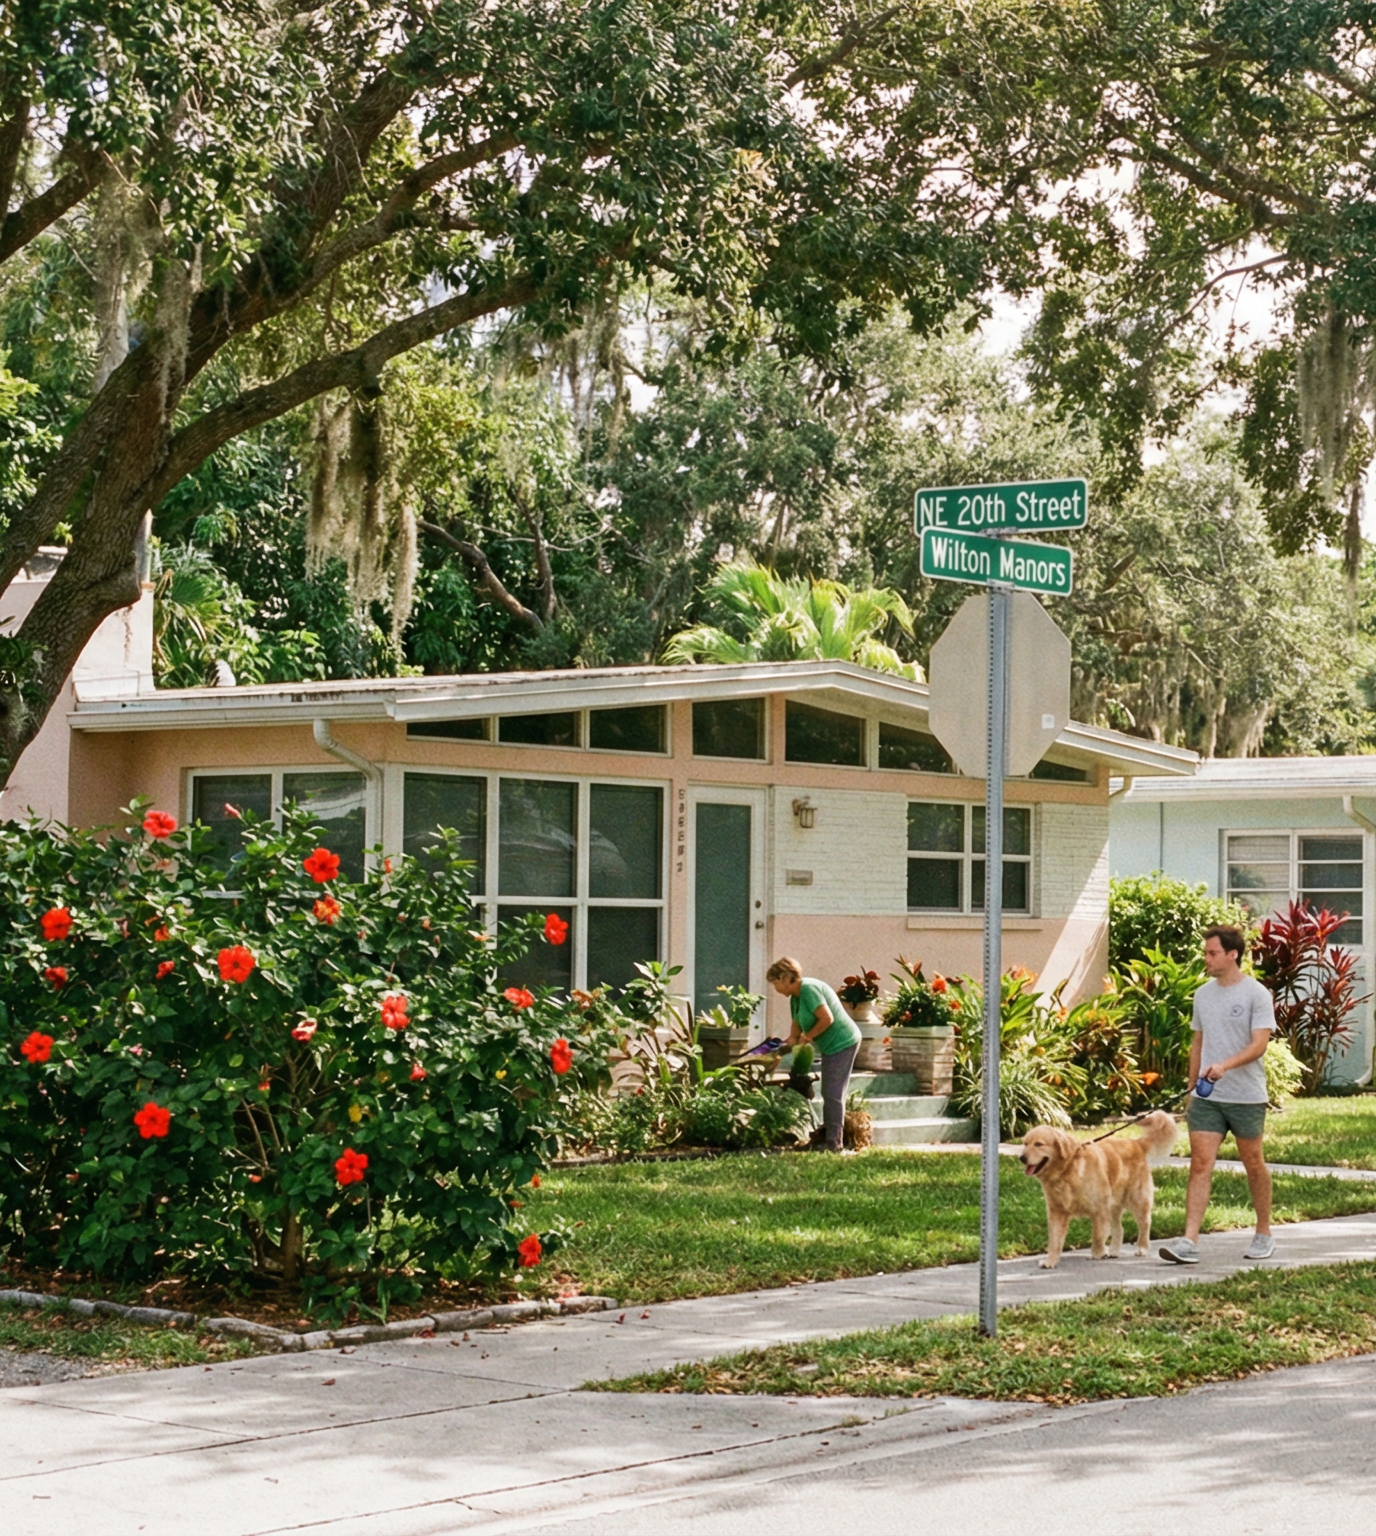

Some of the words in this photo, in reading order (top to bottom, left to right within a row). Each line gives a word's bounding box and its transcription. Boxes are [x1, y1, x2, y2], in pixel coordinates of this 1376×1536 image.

[920, 497, 948, 527] NE
[957, 492, 1006, 525] 20th
[1015, 489, 1081, 522] Street
[931, 536, 990, 575] Wilton
[1000, 547, 1066, 586] Manors
